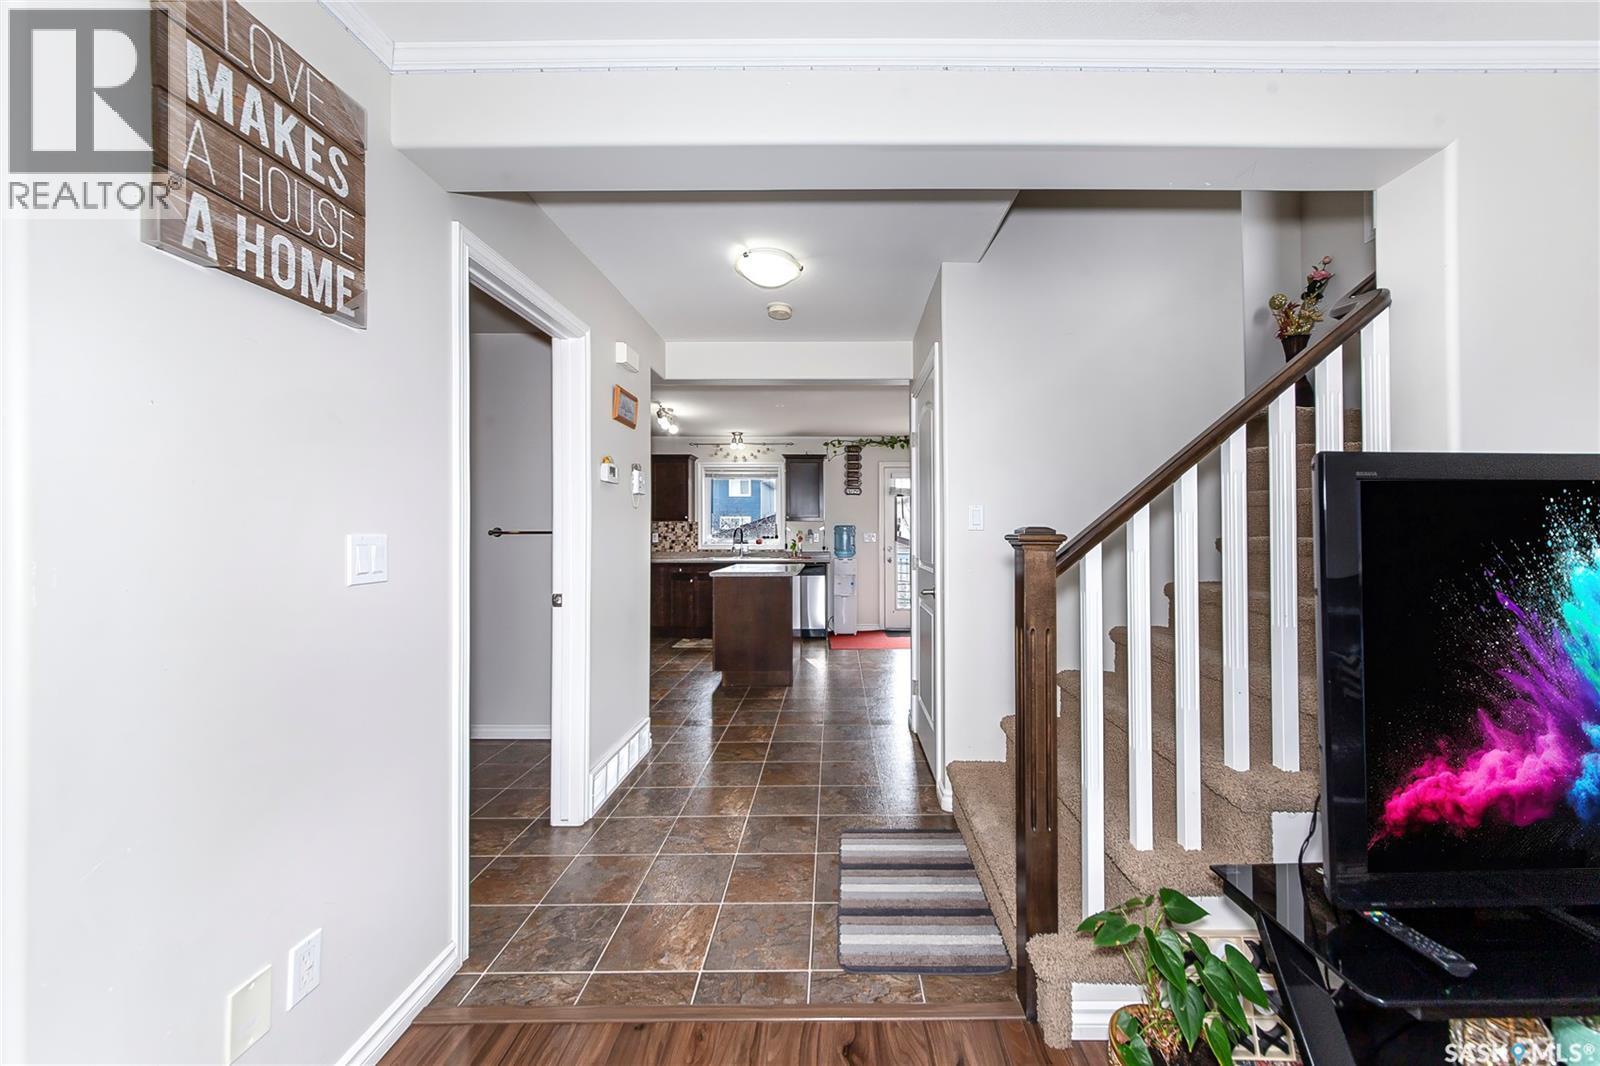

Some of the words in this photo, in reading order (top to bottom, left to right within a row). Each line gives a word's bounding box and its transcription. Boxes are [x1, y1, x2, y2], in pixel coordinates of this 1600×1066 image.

[186, 39, 350, 199] MAKES
[222, 0, 325, 127] LOVE
[182, 191, 218, 260] A
[236, 214, 356, 317] HOME
[183, 119, 216, 186] A
[238, 145, 356, 261] HOUSE
